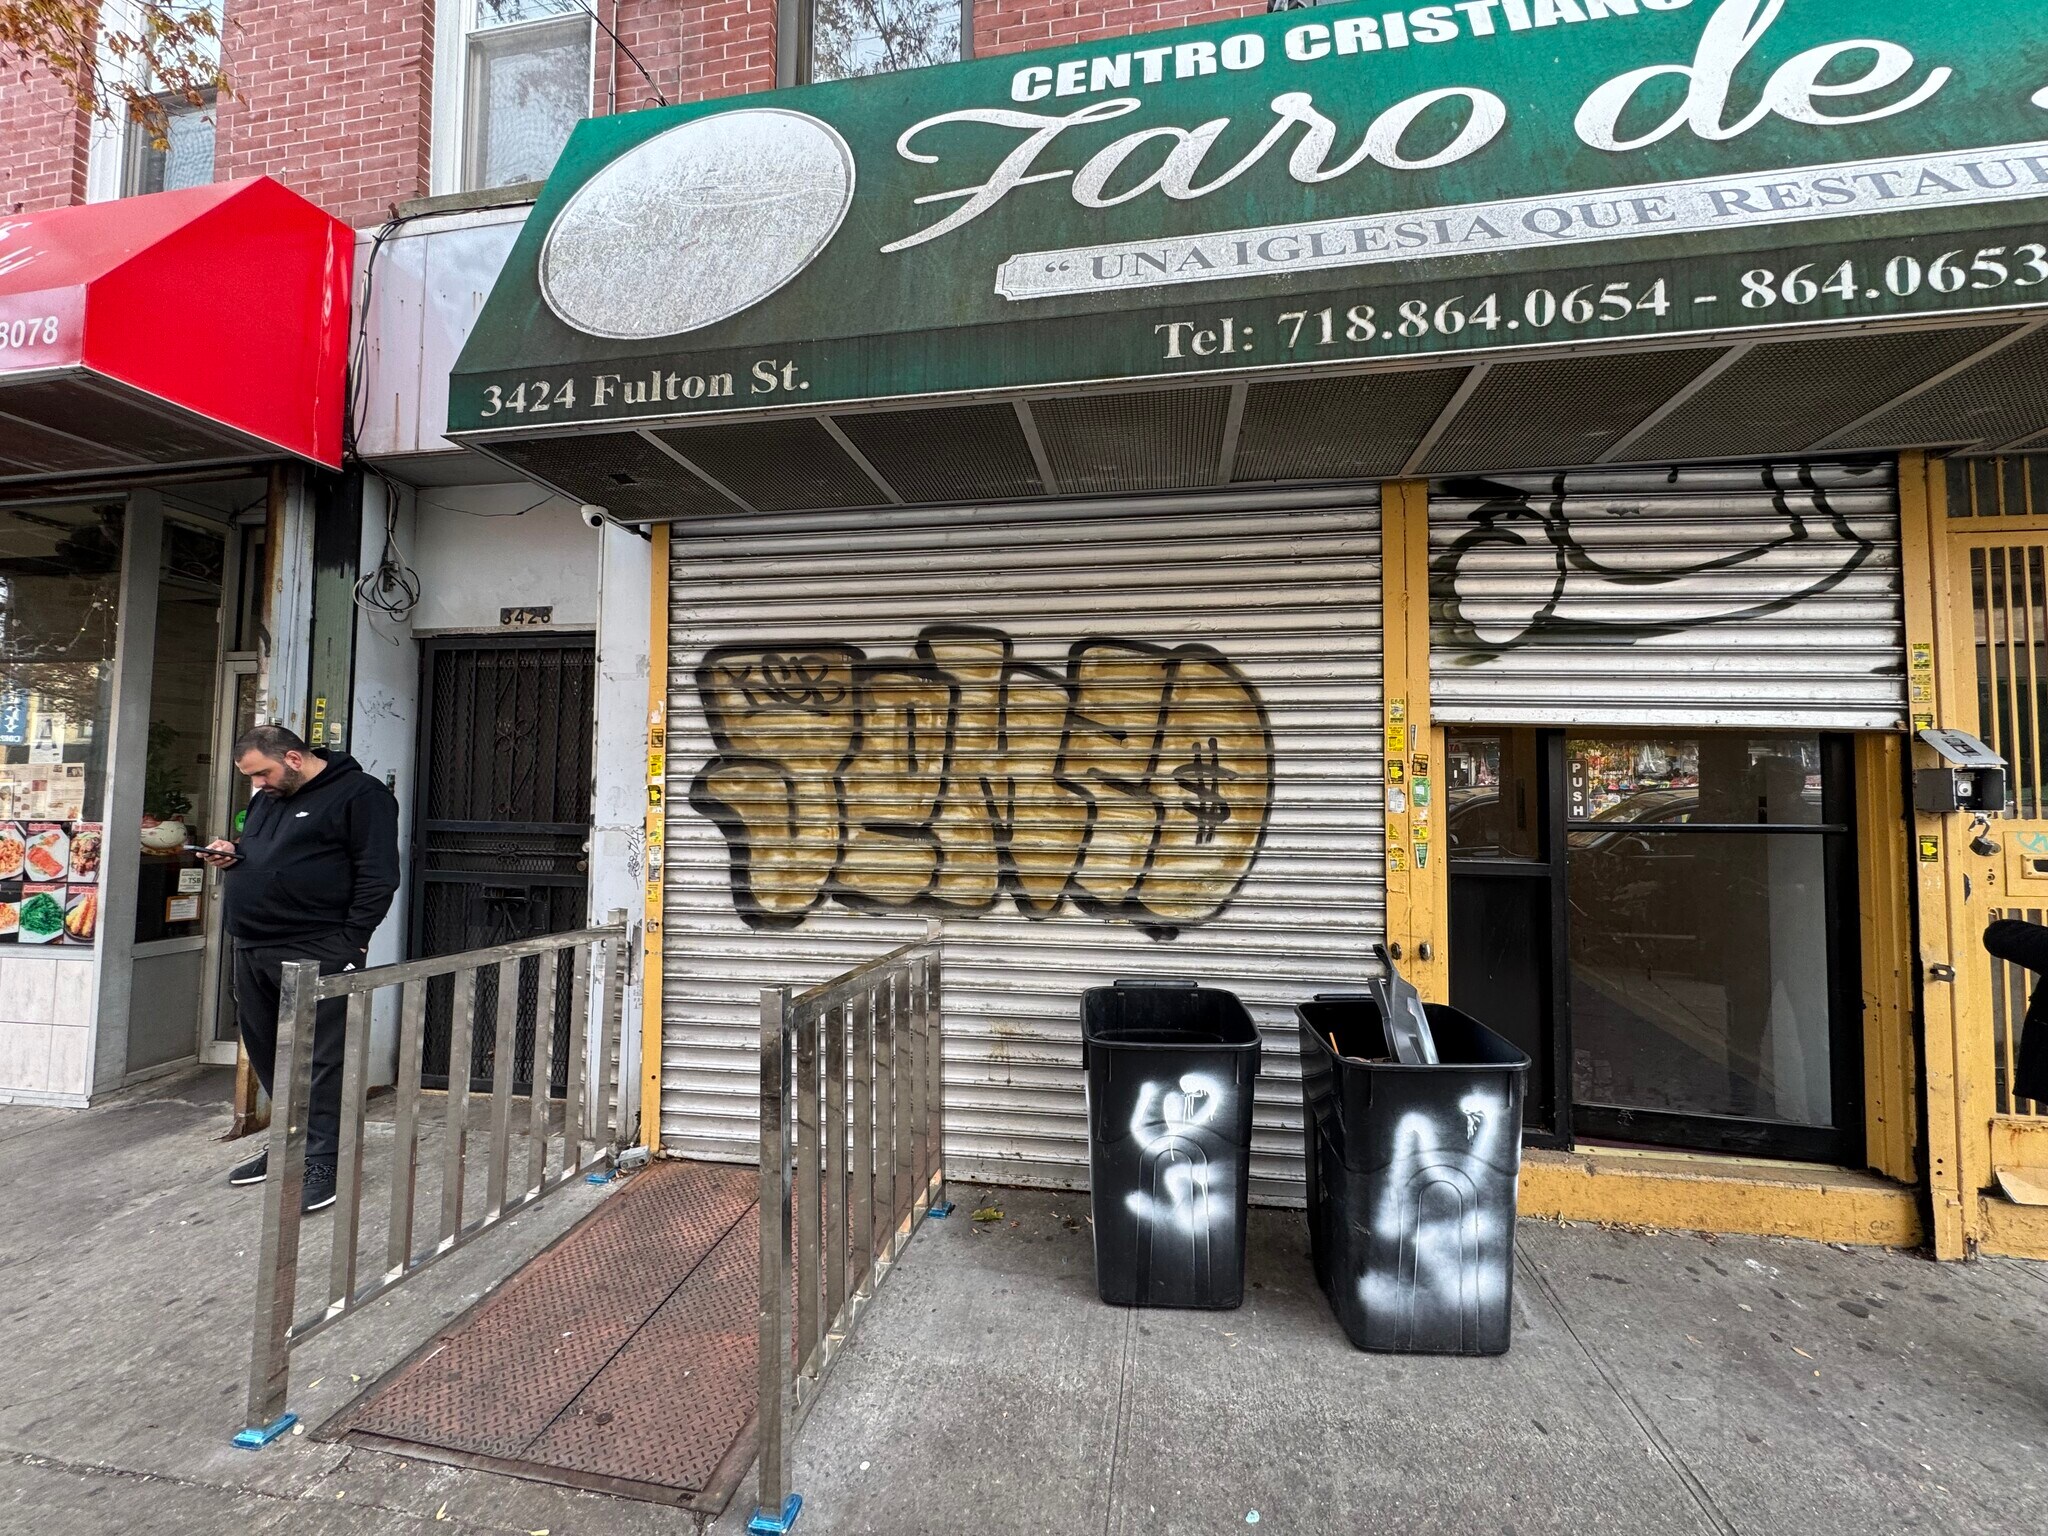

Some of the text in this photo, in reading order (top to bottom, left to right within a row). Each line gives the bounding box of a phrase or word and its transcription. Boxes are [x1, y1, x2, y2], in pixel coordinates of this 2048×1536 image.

[1011, 0, 1694, 102] CENTRO CRISTIA
[880, 0, 1953, 254] Faro de
[1091, 246, 1216, 280] UNA
[1231, 215, 1508, 266] IGLESIA
[1522, 195, 1676, 239] QUE
[1154, 317, 1253, 359] Tel:
[1277, 278, 1670, 349] 718.864.0654
[1741, 243, 2048, 309] 864.0653
[480, 359, 809, 418] 3424 Fulton St.
[1571, 762, 1584, 817] PUSH
